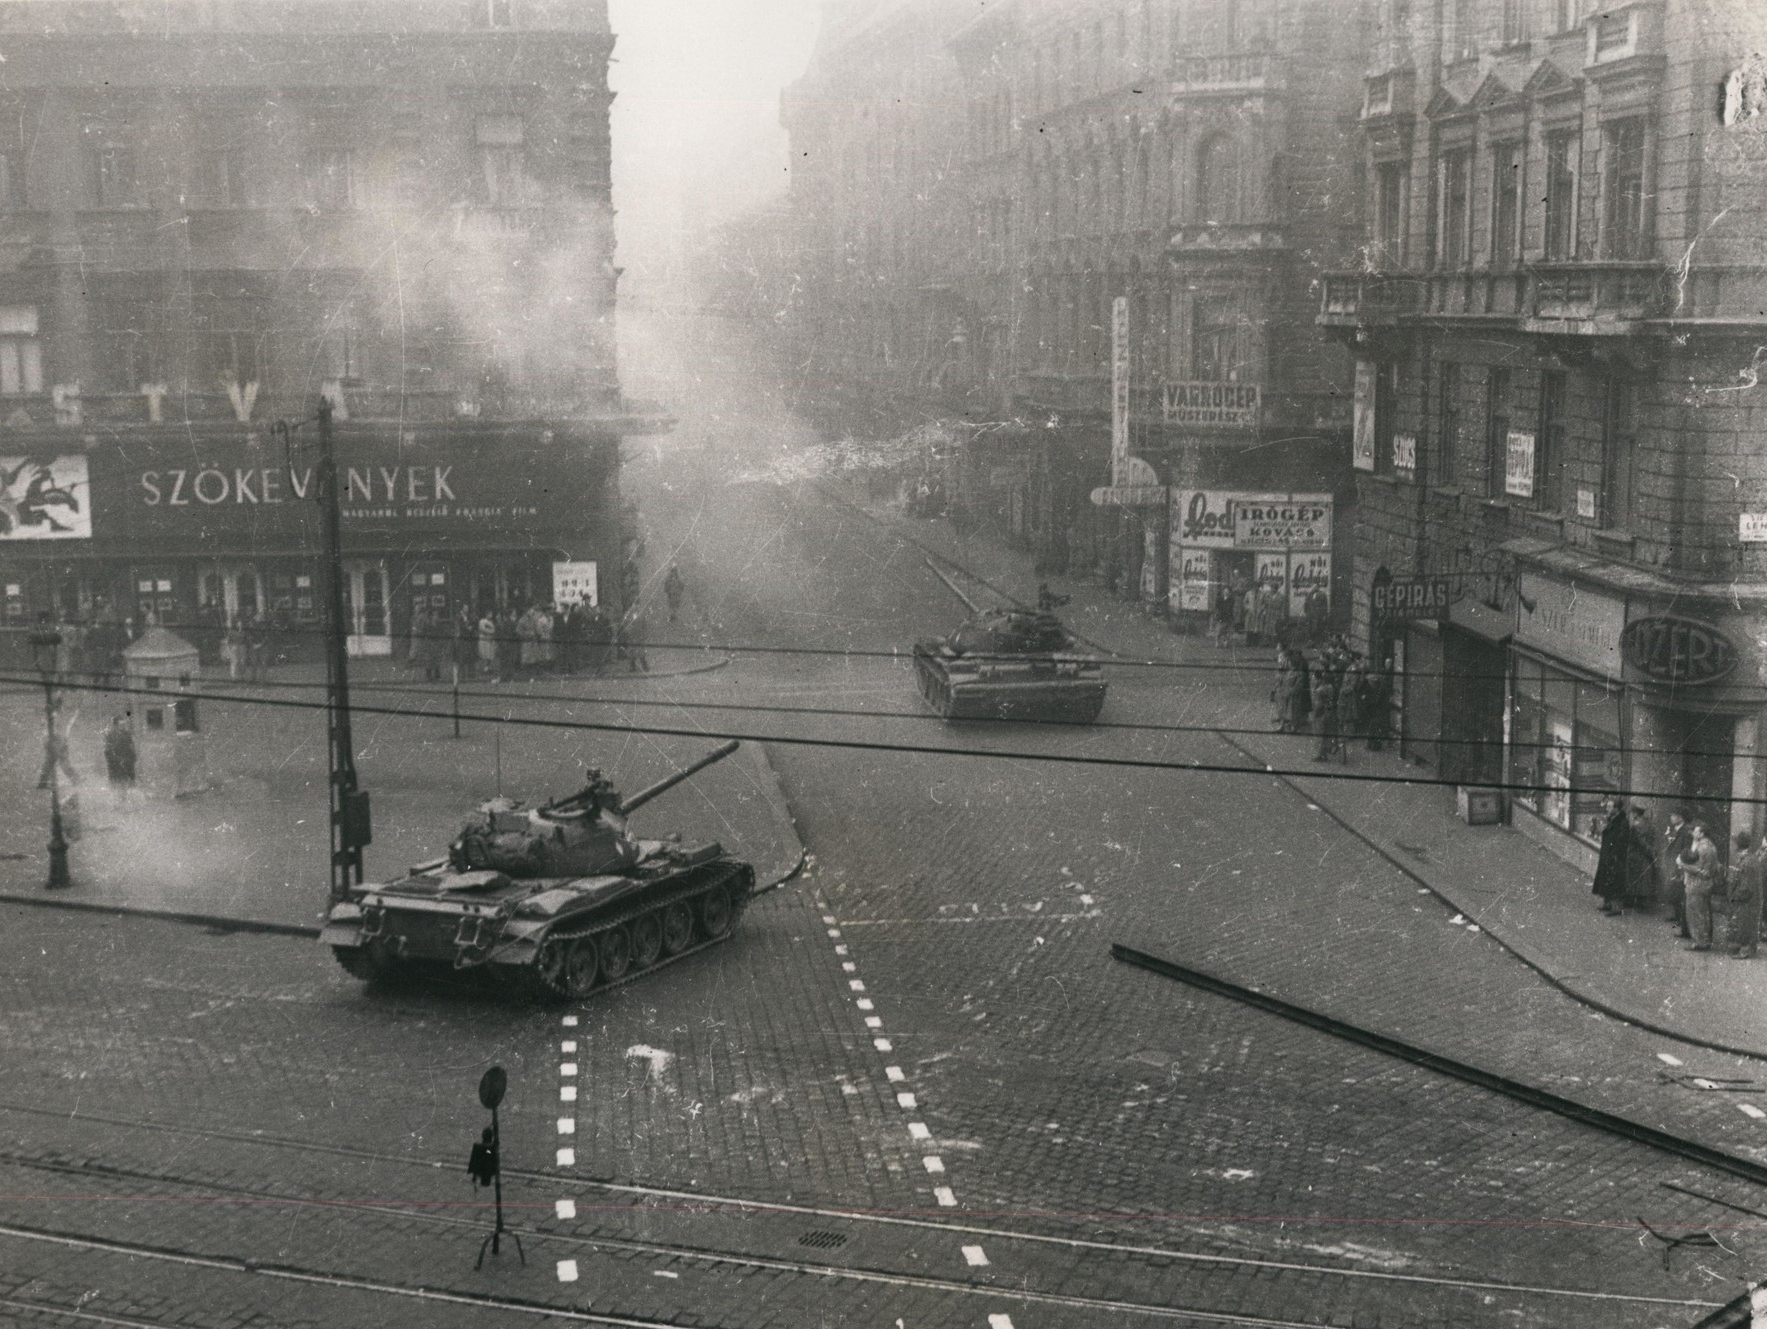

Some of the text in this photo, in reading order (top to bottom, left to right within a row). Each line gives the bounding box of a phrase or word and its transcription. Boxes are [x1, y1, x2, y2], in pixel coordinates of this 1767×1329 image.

[141, 462, 455, 506] SZÖKEVNYEK
[511, 505, 537, 516] FILM
[1241, 505, 1324, 521] IRÓGÉP
[1250, 526, 1315, 538] KOVÁCS
